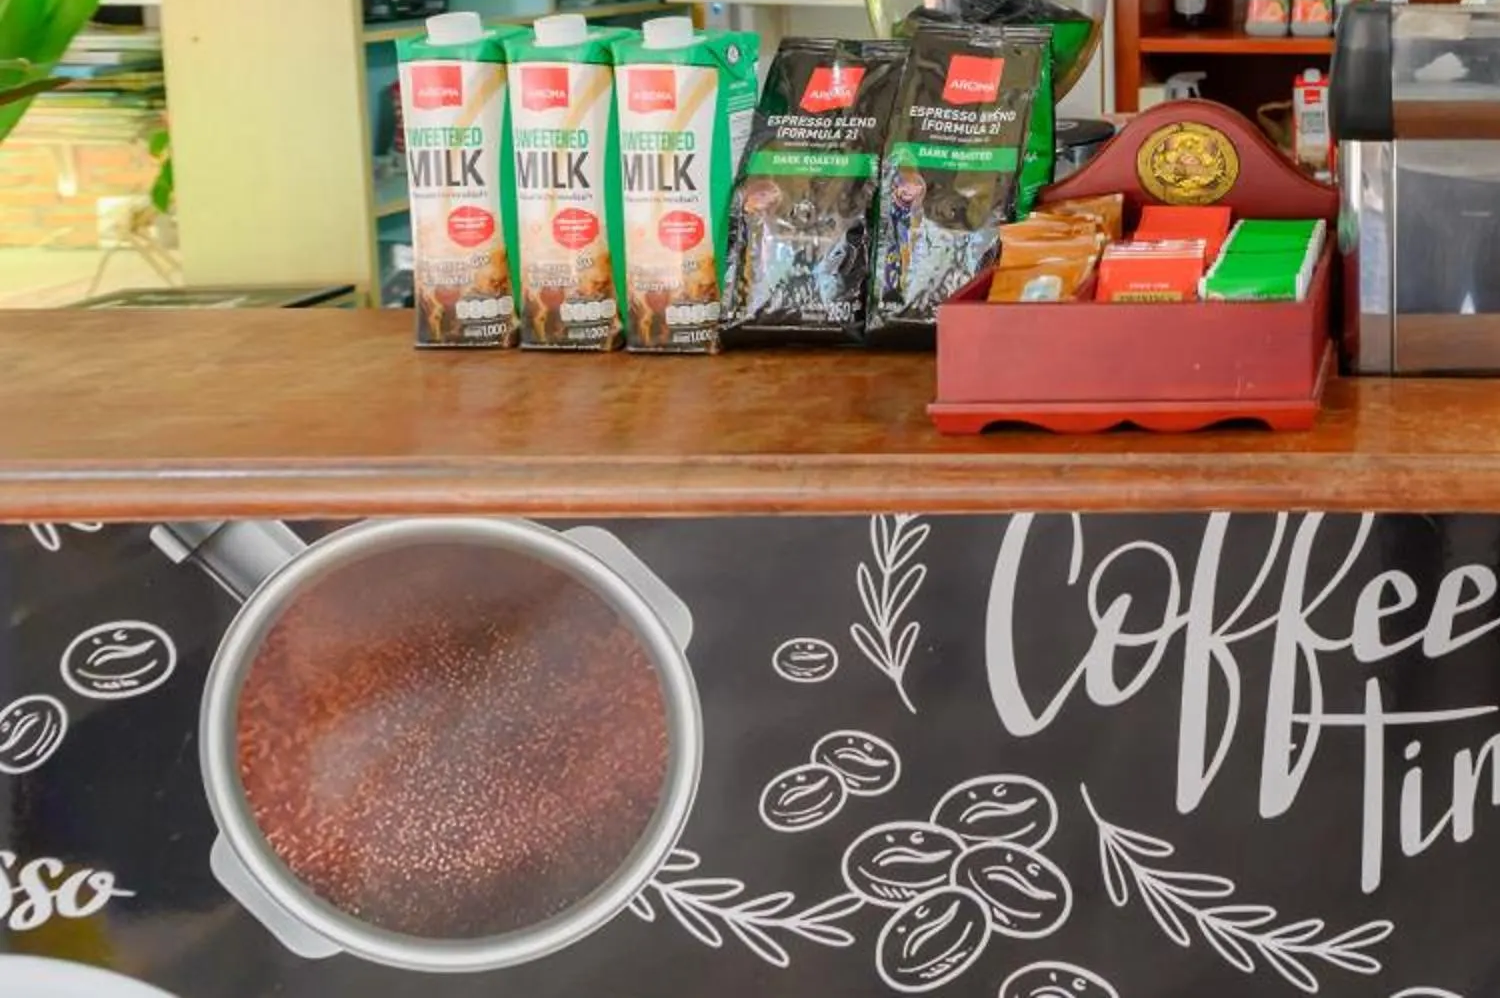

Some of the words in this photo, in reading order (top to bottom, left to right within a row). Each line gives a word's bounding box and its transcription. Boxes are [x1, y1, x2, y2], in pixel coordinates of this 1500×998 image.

[767, 115, 832, 128] ESPRESSO
[835, 117, 877, 128] BLEND
[909, 106, 977, 122] ESPRESSO
[410, 149, 485, 187] MILK
[517, 151, 591, 189] MILK
[623, 153, 697, 191] MILK
